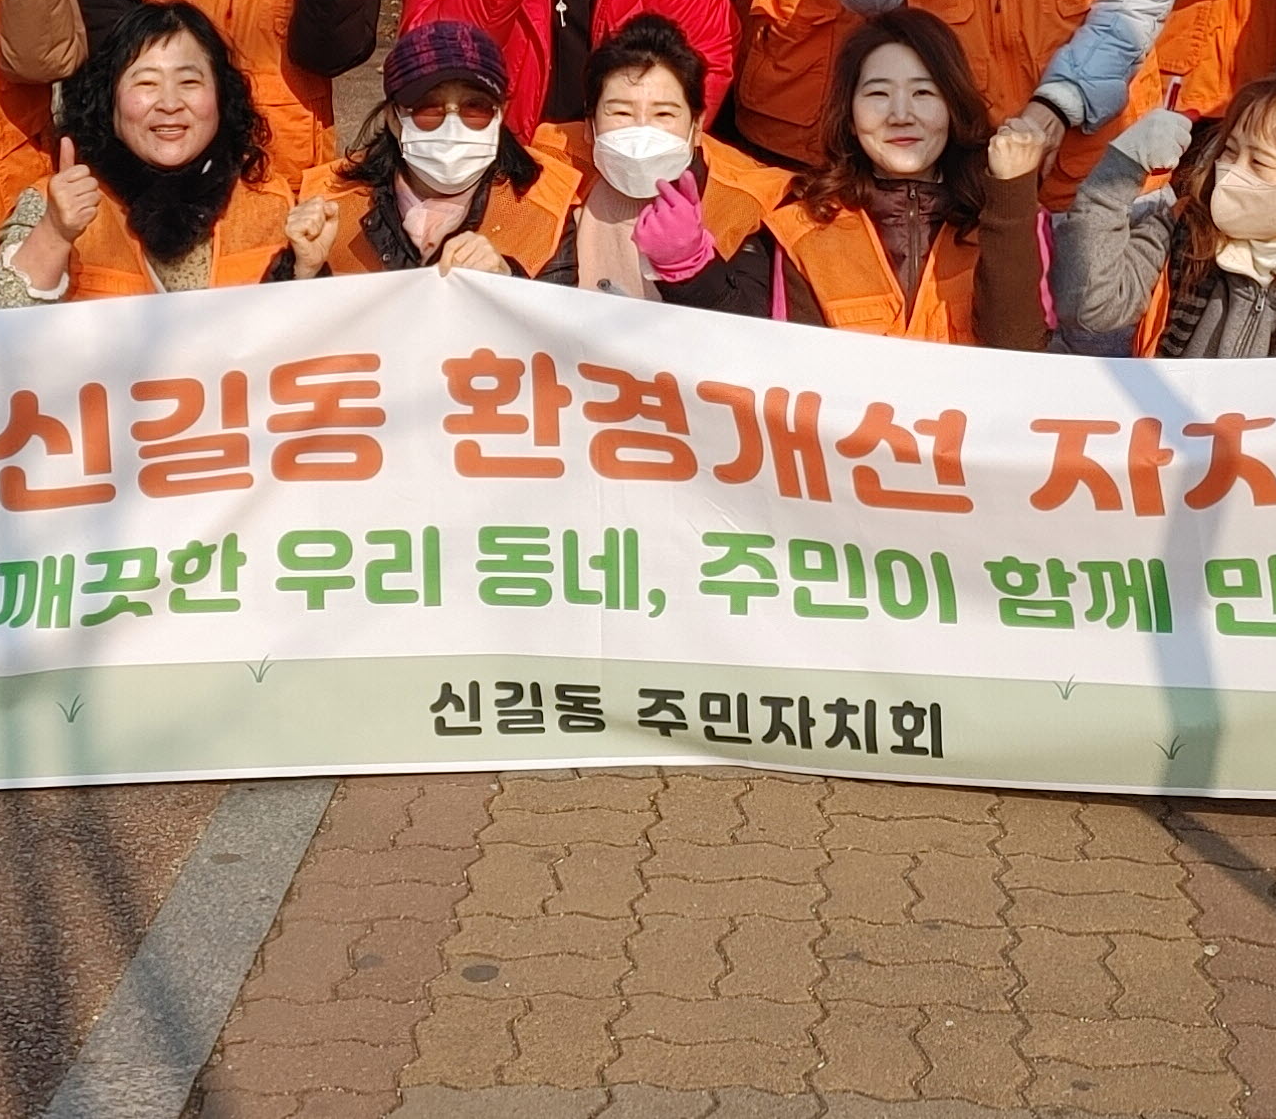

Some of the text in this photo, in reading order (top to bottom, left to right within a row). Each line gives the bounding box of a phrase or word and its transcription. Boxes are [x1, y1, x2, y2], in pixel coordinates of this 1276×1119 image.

[441, 347, 975, 514] 환경개선
[275, 526, 441, 611] 우리
[476, 524, 666, 618] 동네,
[699, 531, 959, 624] 주민이
[983, 554, 1173, 635] 함께
[428, 679, 945, 759] 신길동 주민자치회
